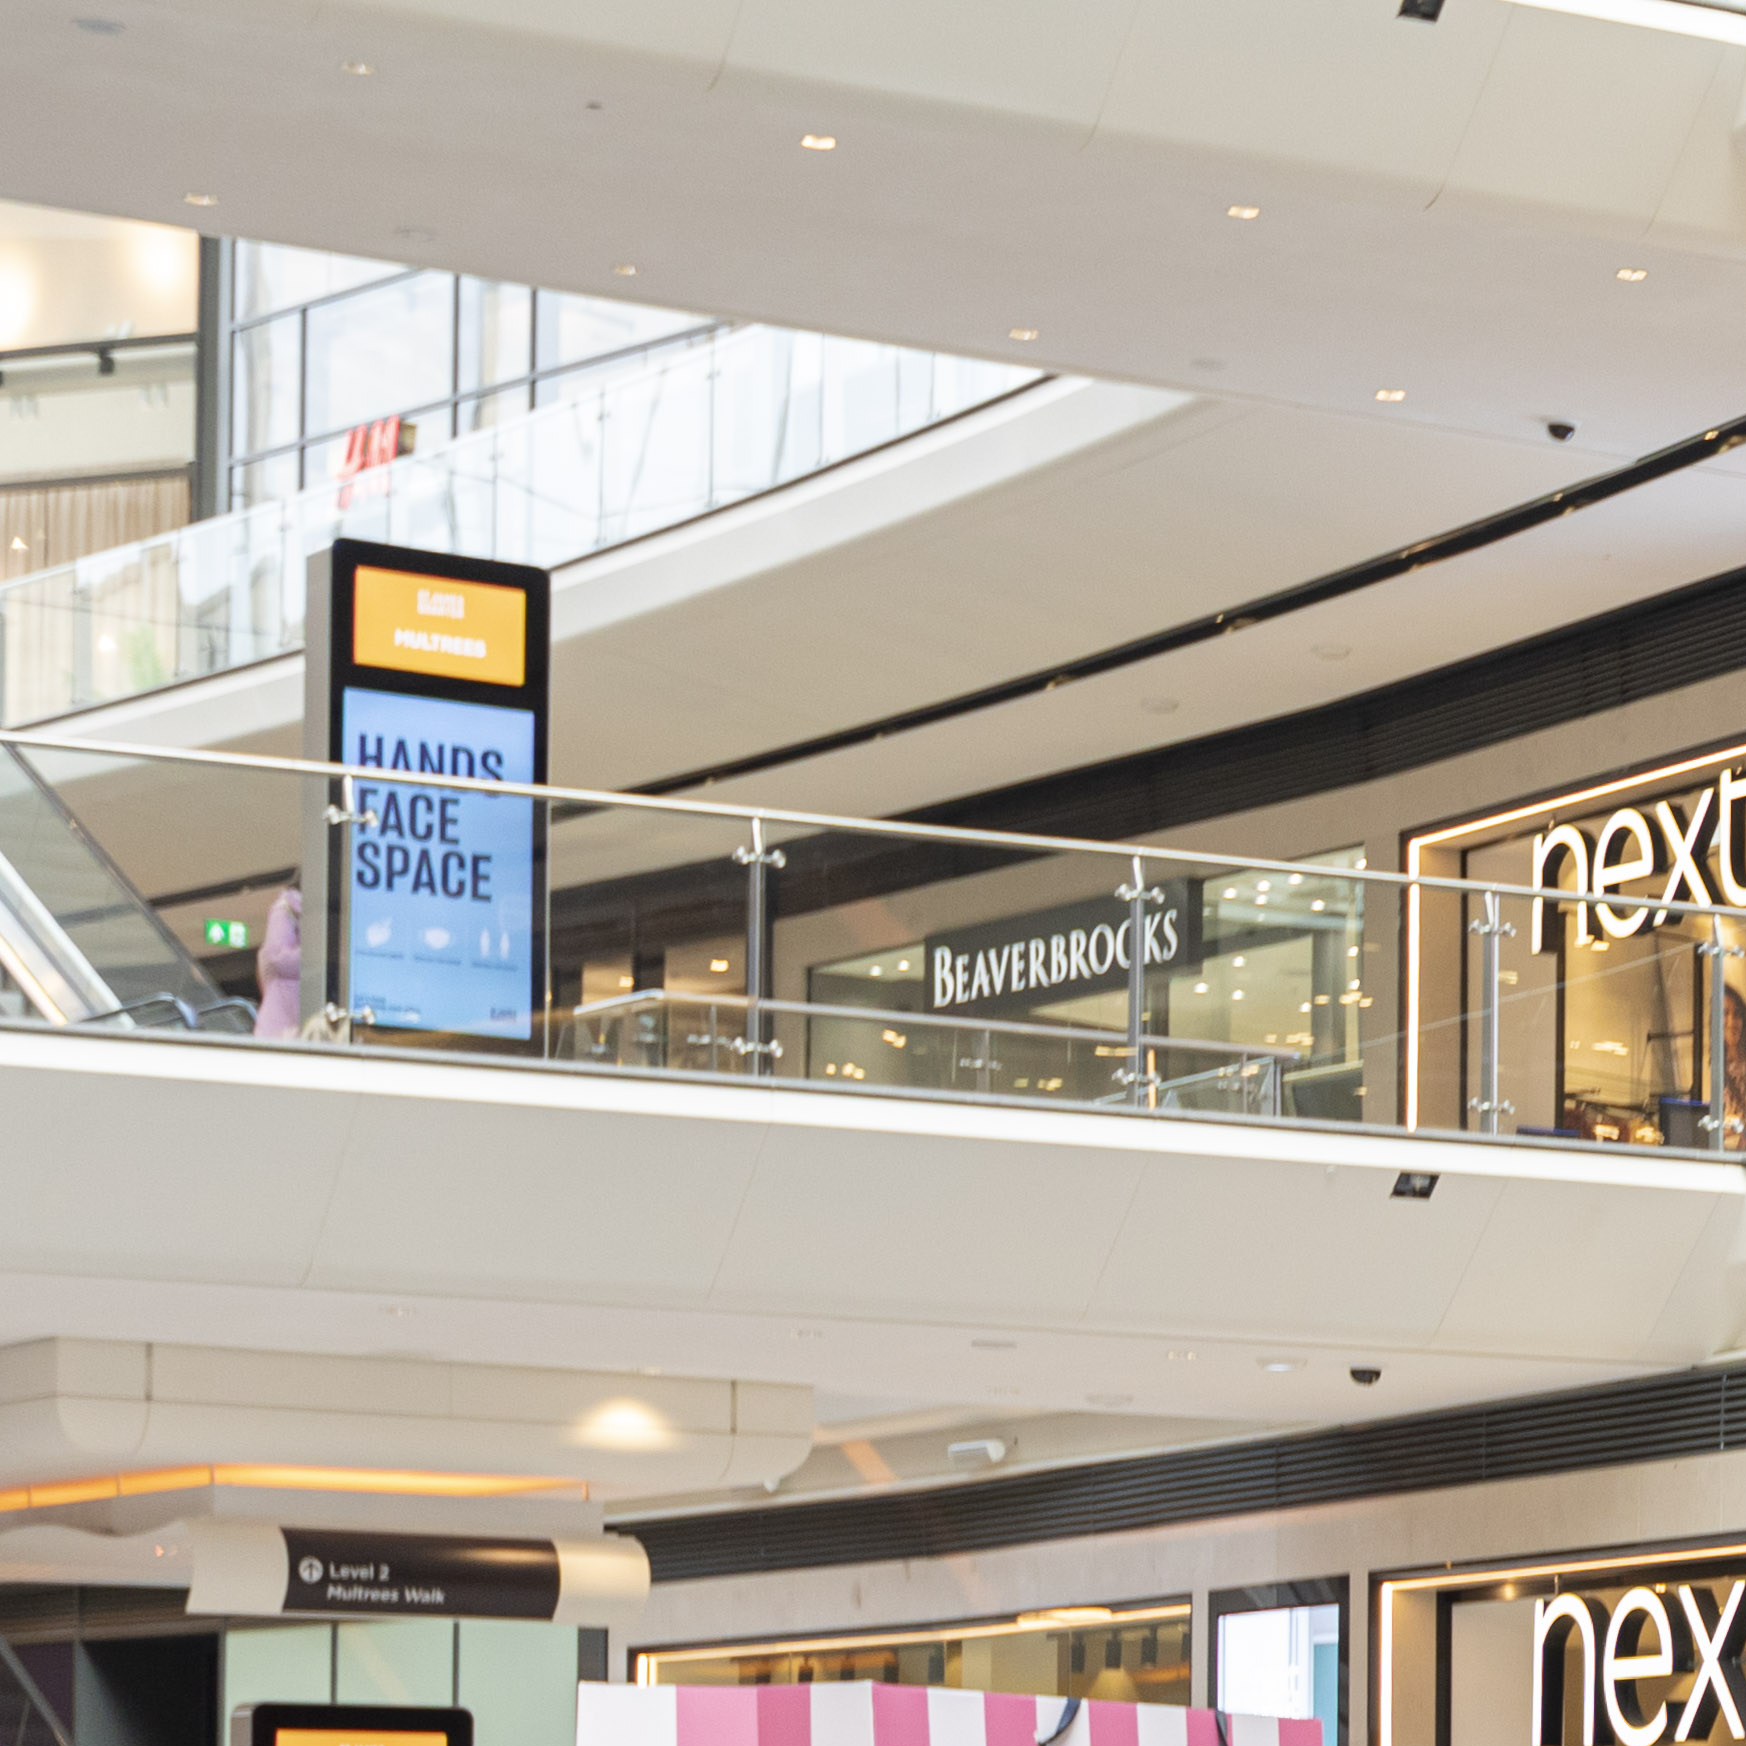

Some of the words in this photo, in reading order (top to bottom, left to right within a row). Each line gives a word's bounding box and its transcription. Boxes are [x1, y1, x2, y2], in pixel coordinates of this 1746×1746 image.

[359, 732, 504, 798] HANDS
[359, 787, 460, 845] FACE
[356, 841, 493, 903] SPACE
[933, 908, 1179, 1009] BEAVERBROOKS
[326, 1583, 400, 1604] Multrees
[404, 1585, 446, 1605] Walk
[329, 1561, 375, 1582] Level
[378, 1562, 390, 1582] 2
